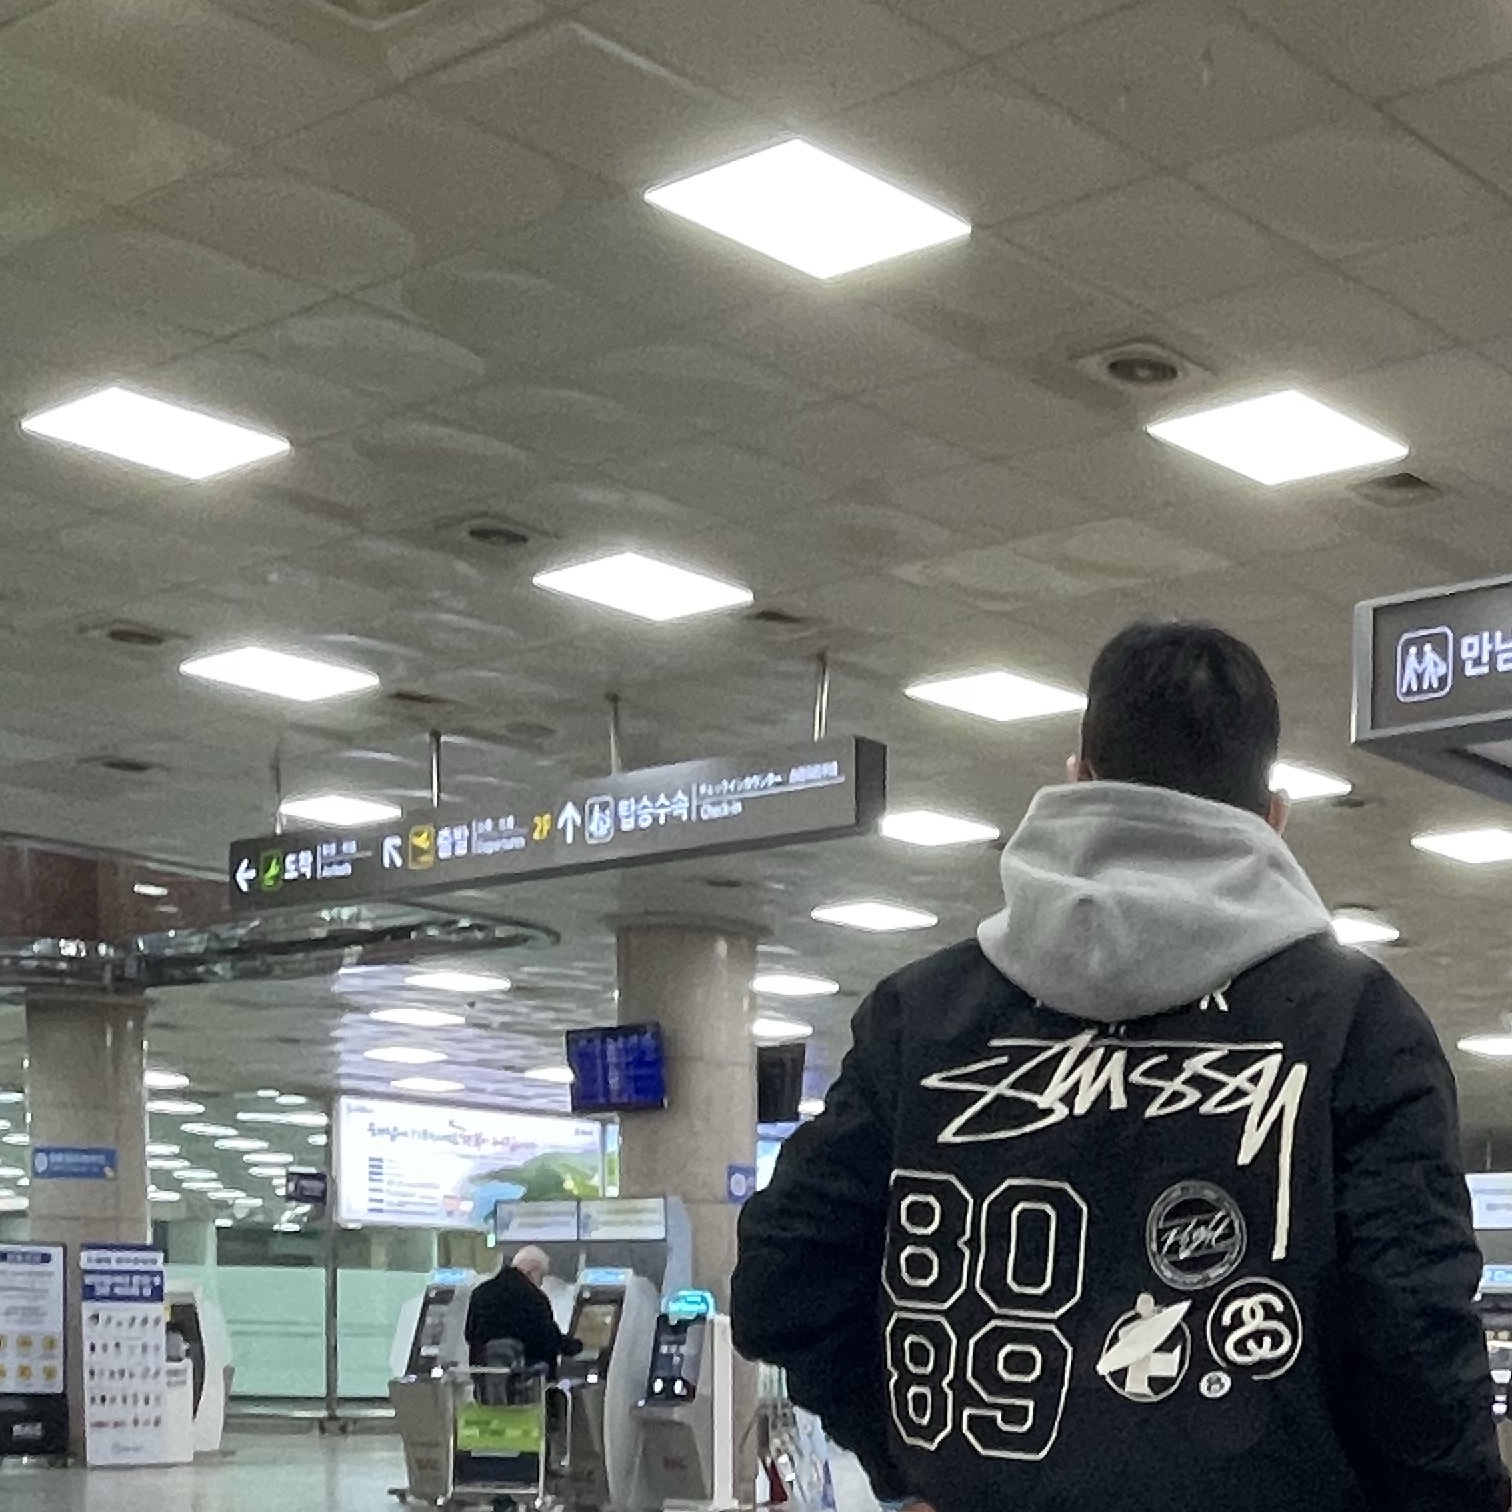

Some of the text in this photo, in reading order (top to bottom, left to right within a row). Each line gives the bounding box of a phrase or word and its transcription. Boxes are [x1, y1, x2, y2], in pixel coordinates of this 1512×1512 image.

[617, 789, 690, 832] 탑승수속
[882, 1169, 1088, 1319] 80
[886, 1311, 1073, 1460] 89
